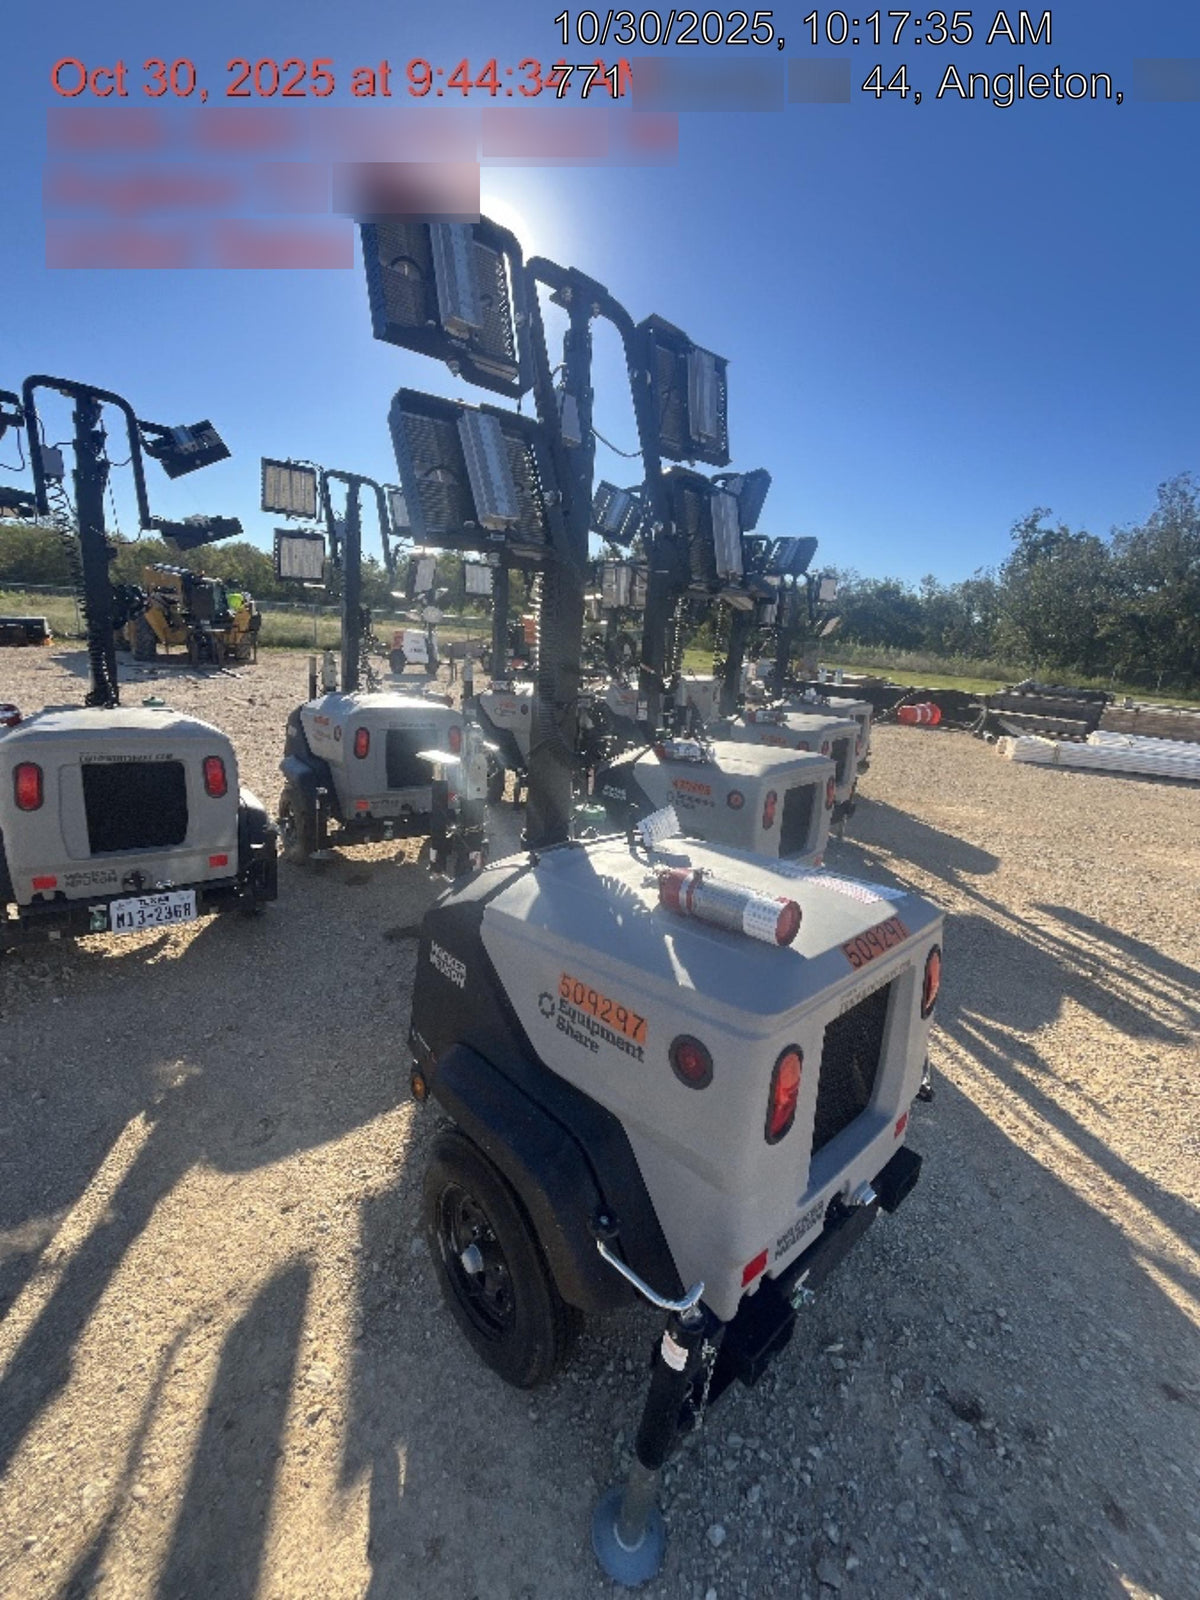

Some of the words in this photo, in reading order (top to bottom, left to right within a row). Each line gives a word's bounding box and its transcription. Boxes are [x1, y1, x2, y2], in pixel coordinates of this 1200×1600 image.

[843, 915, 908, 968] 509297
[555, 1015, 601, 1055] Share
[558, 997, 645, 1064] Equipment
[559, 972, 645, 1040] 509297
